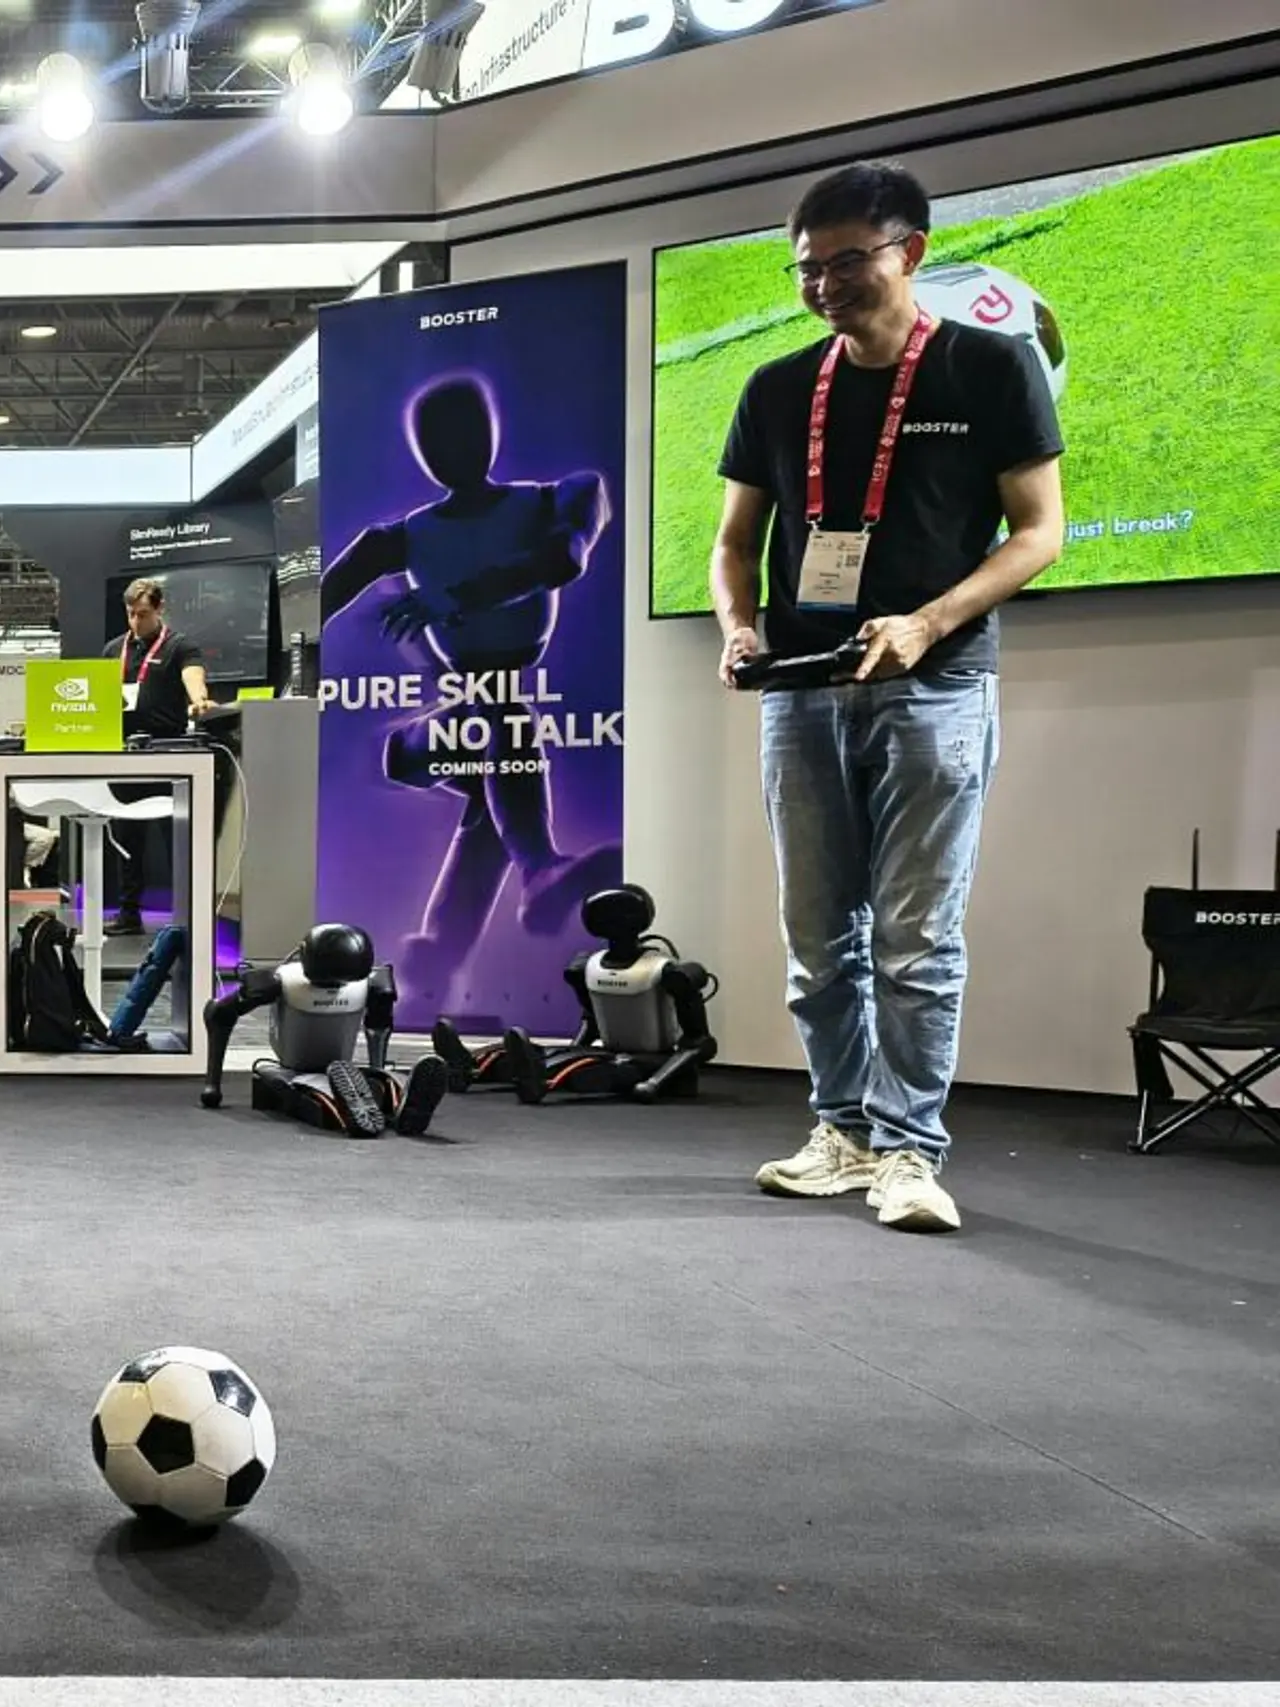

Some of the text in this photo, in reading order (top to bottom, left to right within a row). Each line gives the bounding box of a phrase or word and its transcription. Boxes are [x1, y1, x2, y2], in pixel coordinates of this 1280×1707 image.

[419, 306, 499, 330] BOOSTER
[902, 422, 969, 434] BOOSTER
[1067, 509, 1194, 544] just break?
[318, 668, 563, 712] PURE SKILL
[428, 711, 626, 752] NO TALK
[428, 759, 551, 776] COMING SOON
